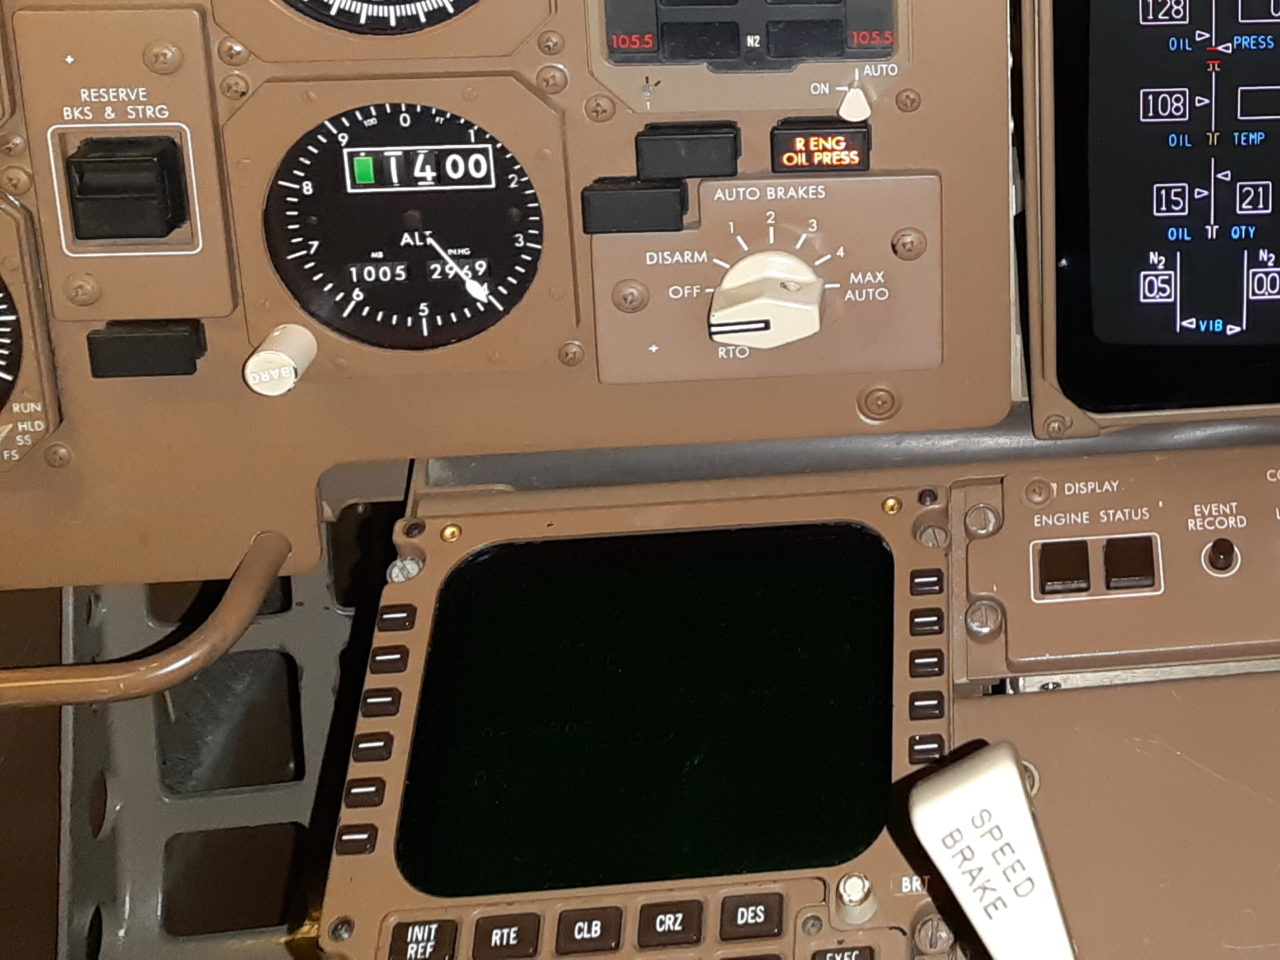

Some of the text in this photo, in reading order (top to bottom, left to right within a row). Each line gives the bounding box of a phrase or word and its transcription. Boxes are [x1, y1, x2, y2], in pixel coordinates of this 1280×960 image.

[746, 35, 761, 48] N2
[1169, 35, 1275, 51] OIL PRESS
[863, 64, 898, 76] AUTO
[80, 88, 147, 102] RESERVE
[810, 83, 830, 95] ON
[63, 105, 169, 120] BKS & STRG
[1147, 94, 1184, 117] 108
[795, 136, 846, 151] R ENG
[1168, 132, 1265, 147] OIL TEMP
[782, 151, 859, 166] OIL PRESS
[714, 185, 826, 200] AUTO BRAKES
[1159, 188, 1184, 211] 15
[1241, 186, 1265, 209] 21
[645, 251, 708, 265] DISARM
[350, 266, 406, 282] 1005
[849, 271, 885, 284] MAX
[668, 286, 701, 299] OFF
[844, 288, 889, 301] AUTO
[1199, 319, 1223, 332] VIB
[718, 346, 750, 359] RTO
[12, 402, 42, 413] RUN
[17, 420, 45, 432] HLD
[15, 435, 32, 446] SS
[1064, 480, 1120, 496] DISPLAY
[1099, 507, 1150, 523] STATUS
[1193, 502, 1239, 517] EVENT
[1033, 511, 1090, 527] ENGINE
[1187, 515, 1247, 531] RECORD
[971, 808, 1036, 899] SPEED
[940, 827, 1009, 921] BRAKE
[737, 905, 765, 924] DES
[574, 919, 601, 940] CLB
[655, 913, 684, 932] CRZ
[406, 923, 439, 943] INIT
[490, 926, 519, 947] RTE
[406, 941, 435, 960] REF
